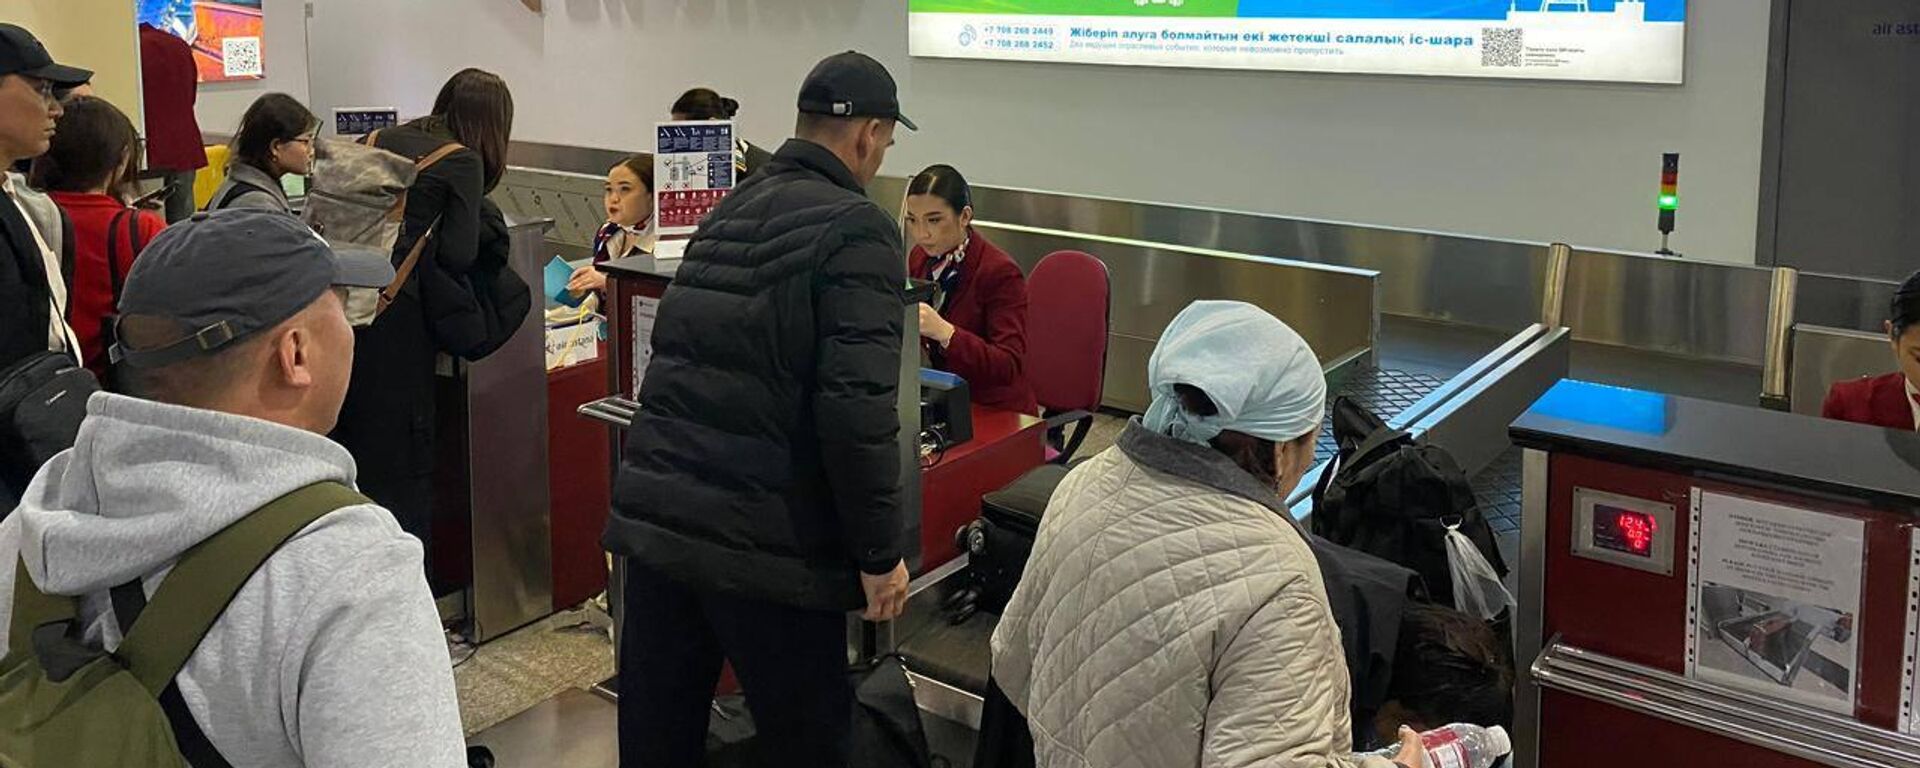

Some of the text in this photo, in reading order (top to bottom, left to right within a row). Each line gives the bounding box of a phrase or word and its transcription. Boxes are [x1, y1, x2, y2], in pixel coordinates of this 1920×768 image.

[1070, 26, 1118, 40] Жіберіп
[1161, 29, 1238, 41] болмайтын
[1243, 31, 1264, 42] екі
[1268, 32, 1331, 43] жетекші
[1335, 34, 1405, 46] салалық
[1409, 33, 1474, 48] іс-шара
[1872, 22, 1890, 35] air
